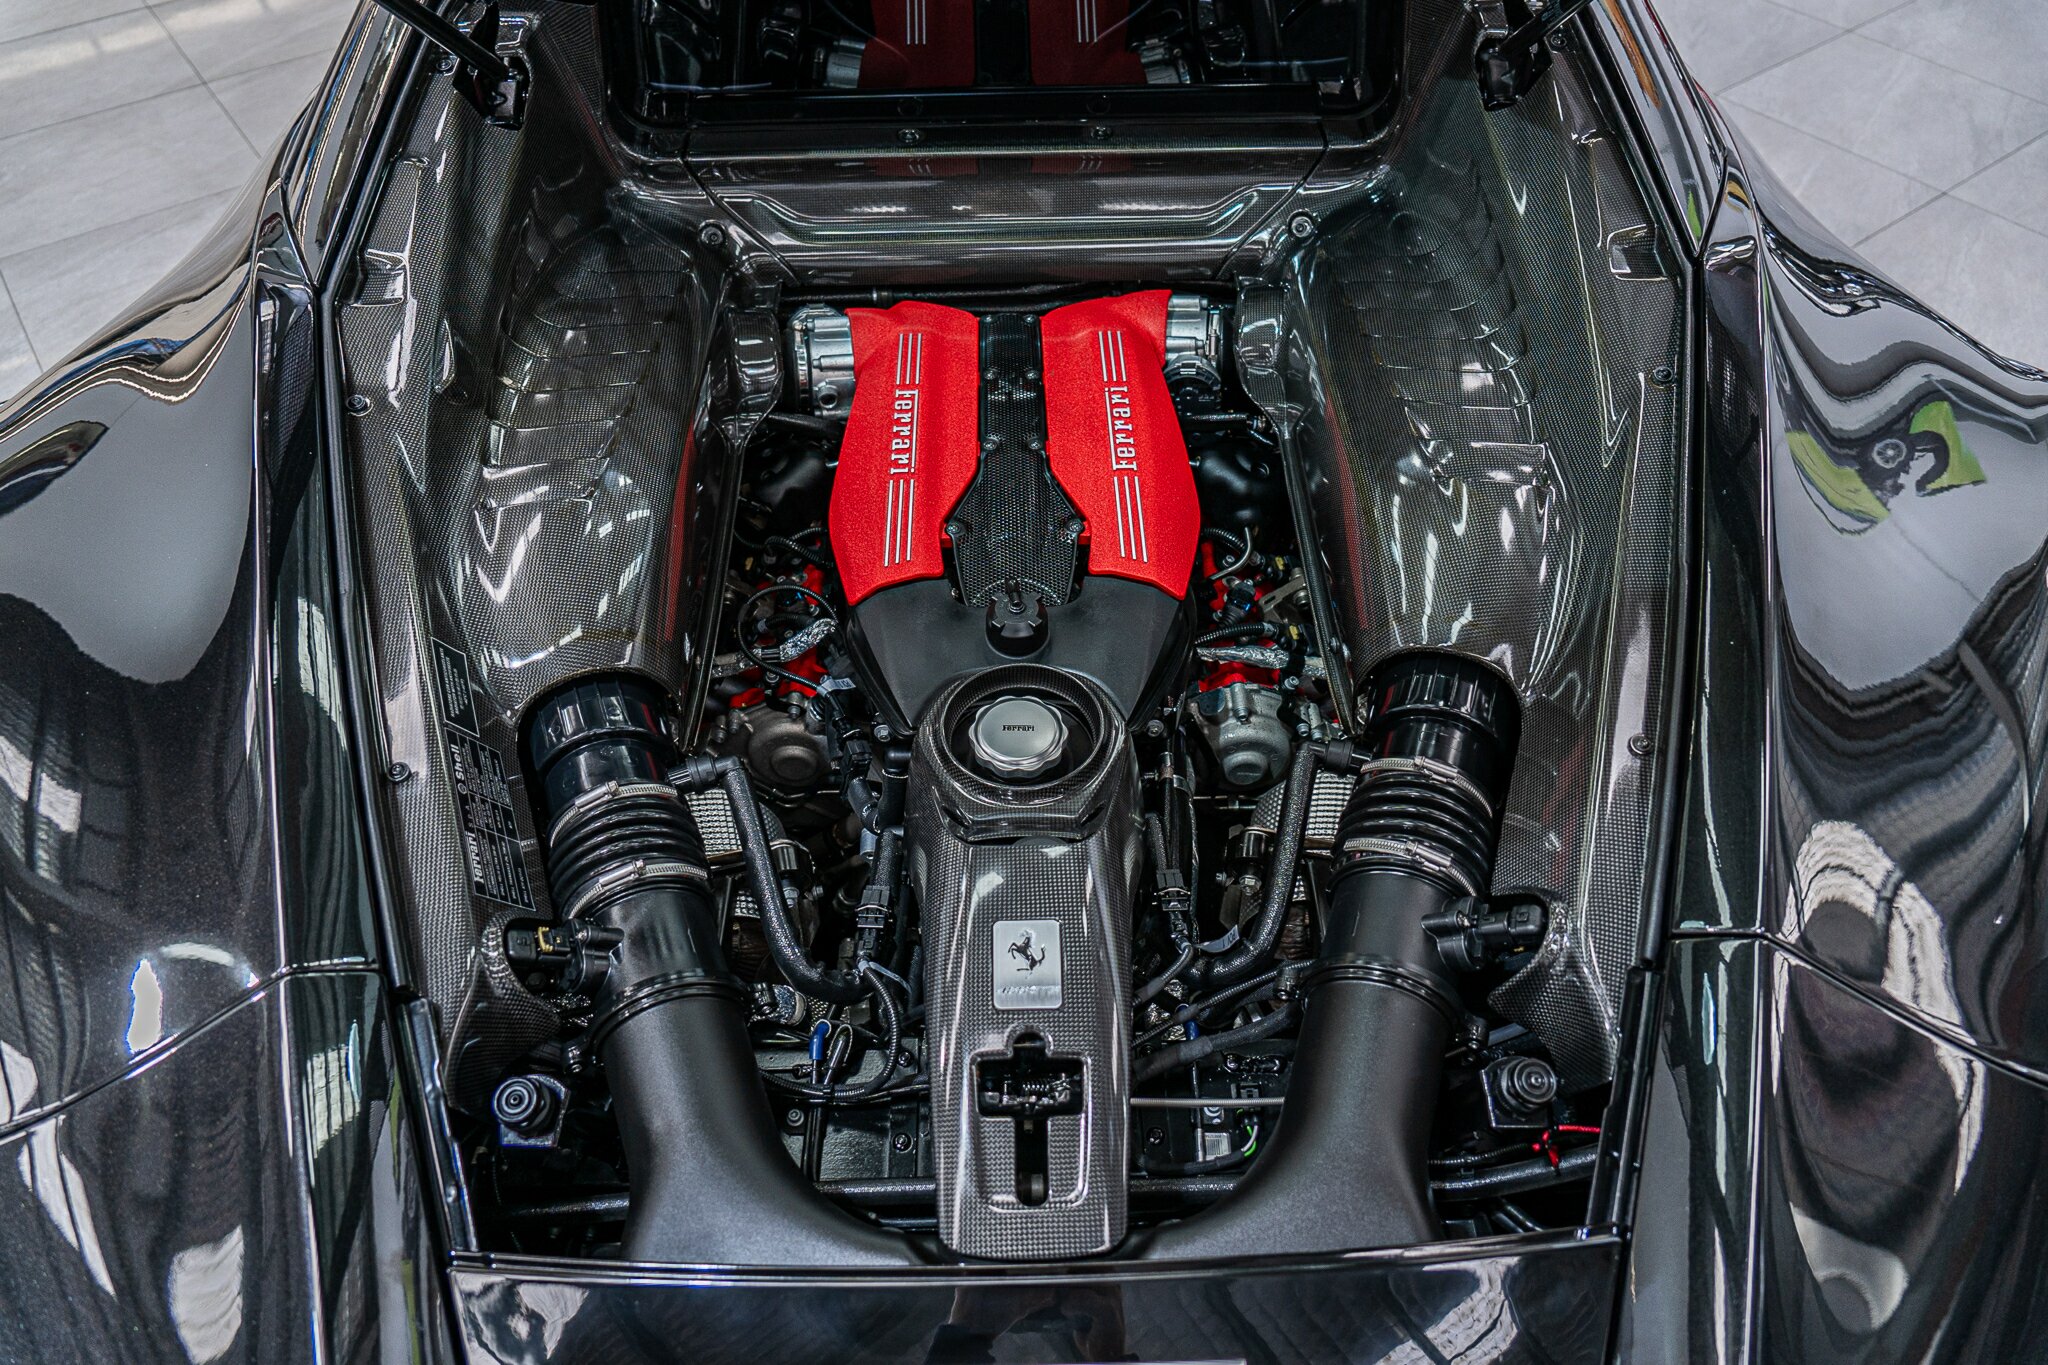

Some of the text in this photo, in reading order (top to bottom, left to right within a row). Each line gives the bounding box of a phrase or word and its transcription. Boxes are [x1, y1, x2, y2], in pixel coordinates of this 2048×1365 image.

[890, 389, 919, 475] Ferrari
[1104, 386, 1138, 471] Ferrari
[1002, 724, 1035, 732] Ferrari
[450, 743, 464, 781] Shell
[464, 830, 485, 884] Ferrari
